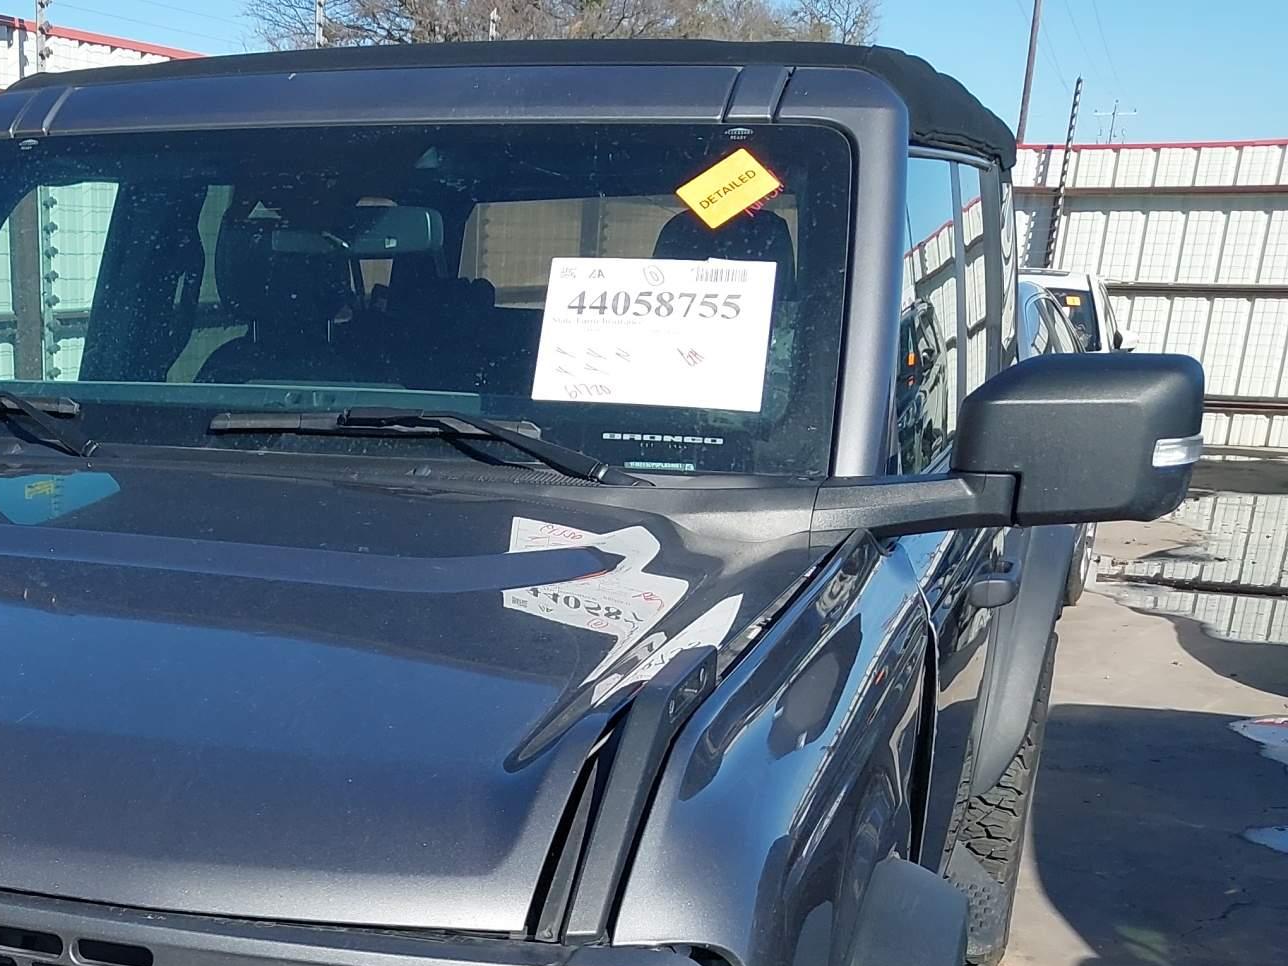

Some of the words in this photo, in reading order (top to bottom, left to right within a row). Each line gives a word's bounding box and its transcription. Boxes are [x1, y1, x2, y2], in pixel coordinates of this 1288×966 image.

[699, 169, 757, 210] DETAILED
[567, 290, 743, 320] 44058755
[602, 432, 724, 445] BRONCO
